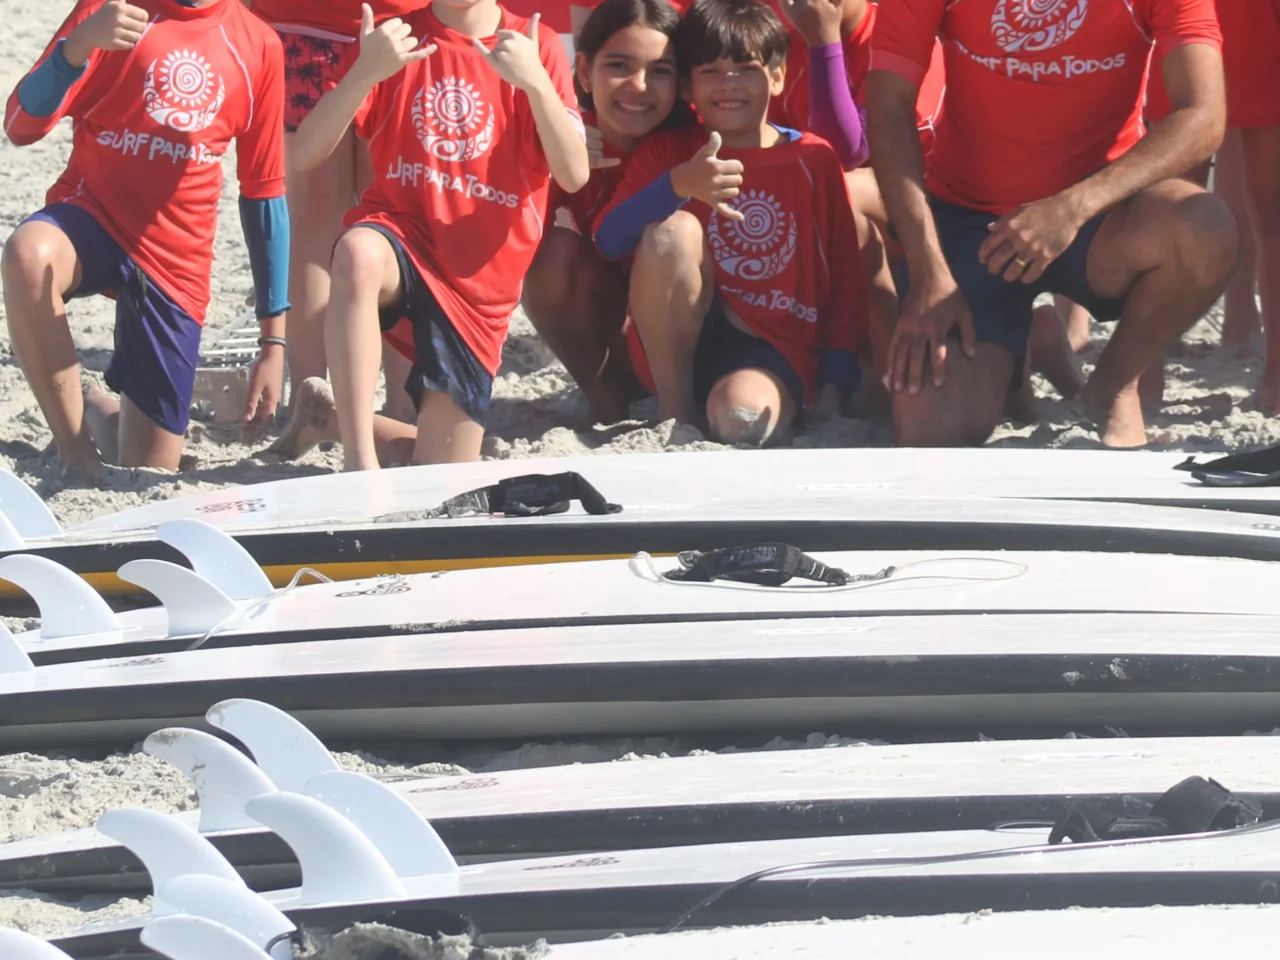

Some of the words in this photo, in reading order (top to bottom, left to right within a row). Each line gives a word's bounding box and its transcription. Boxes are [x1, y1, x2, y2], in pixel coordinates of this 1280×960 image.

[1006, 57, 1062, 82] PARA
[1061, 53, 1126, 78] TODOS
[96, 128, 150, 155] SURF
[148, 136, 197, 164] PARA
[386, 155, 424, 188] URF
[465, 174, 519, 208] TODOS
